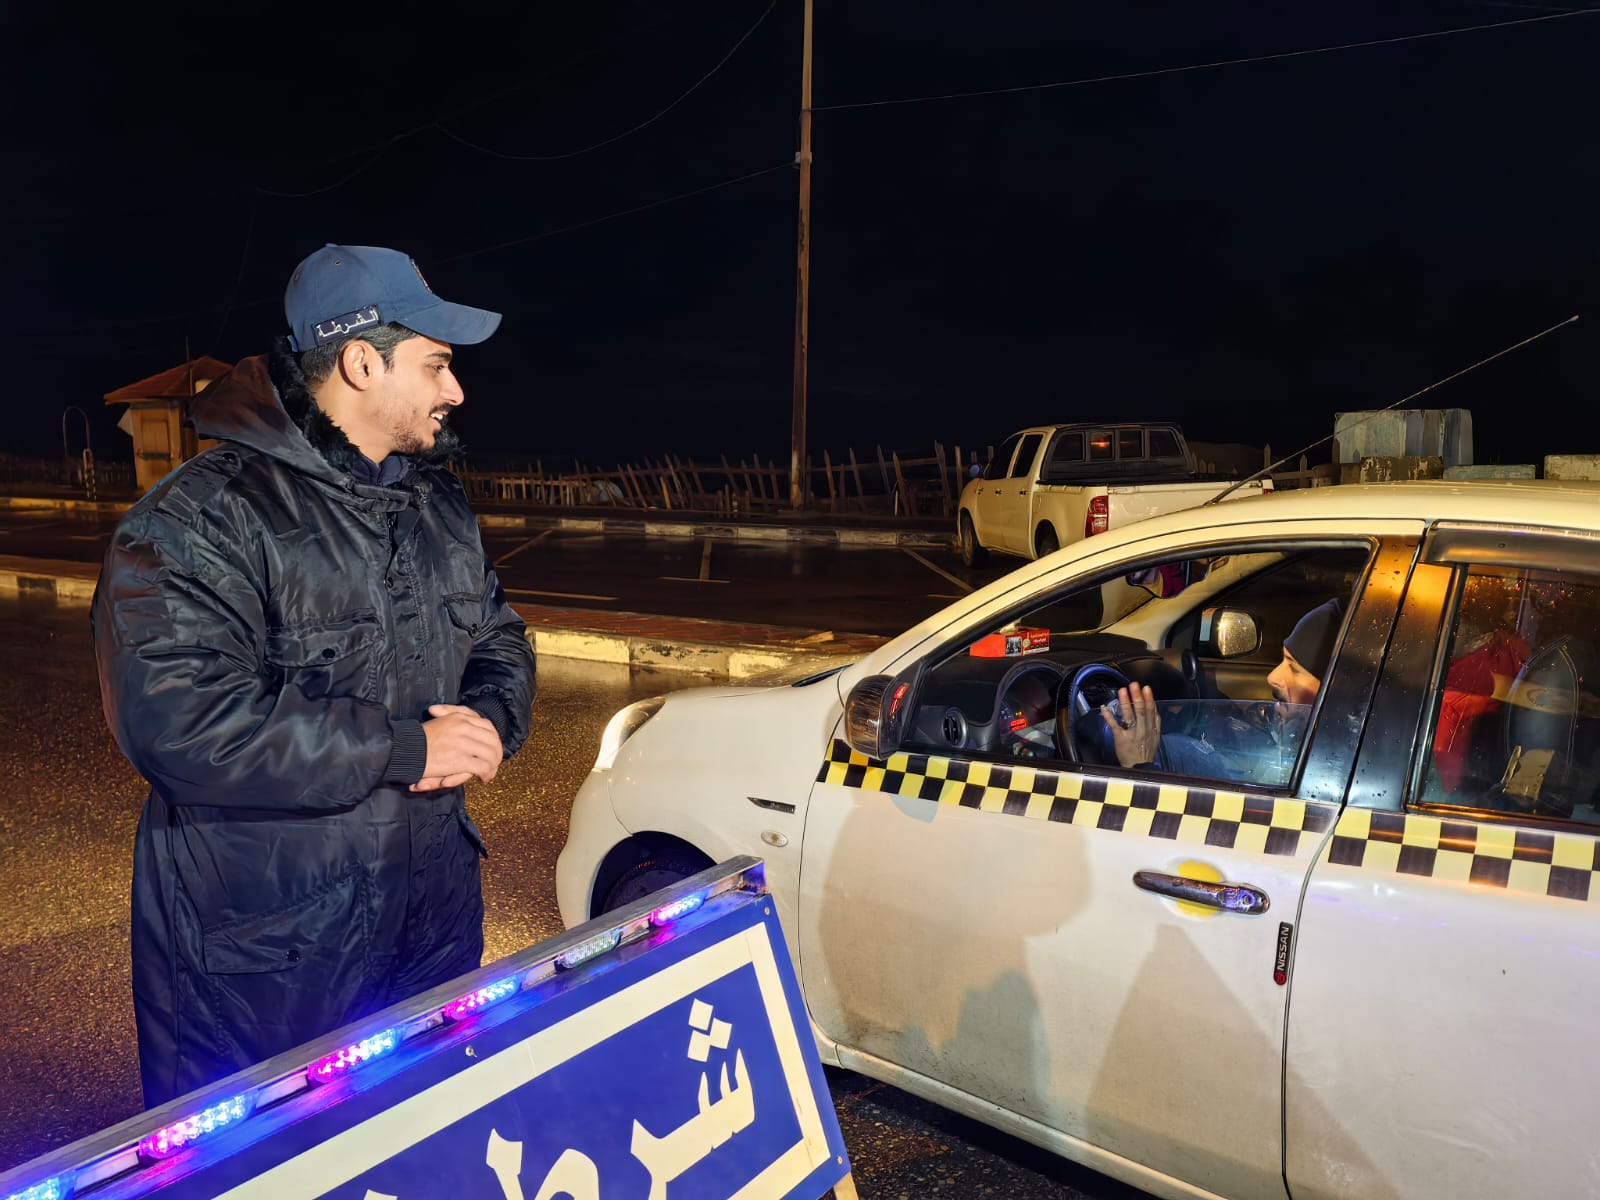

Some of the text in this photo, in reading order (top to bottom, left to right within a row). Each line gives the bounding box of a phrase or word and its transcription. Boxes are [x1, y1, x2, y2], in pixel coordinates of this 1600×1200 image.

[315, 305, 379, 337] الشرطة
[1277, 926, 1290, 971] NISSAN
[364, 997, 756, 1200] شرط
